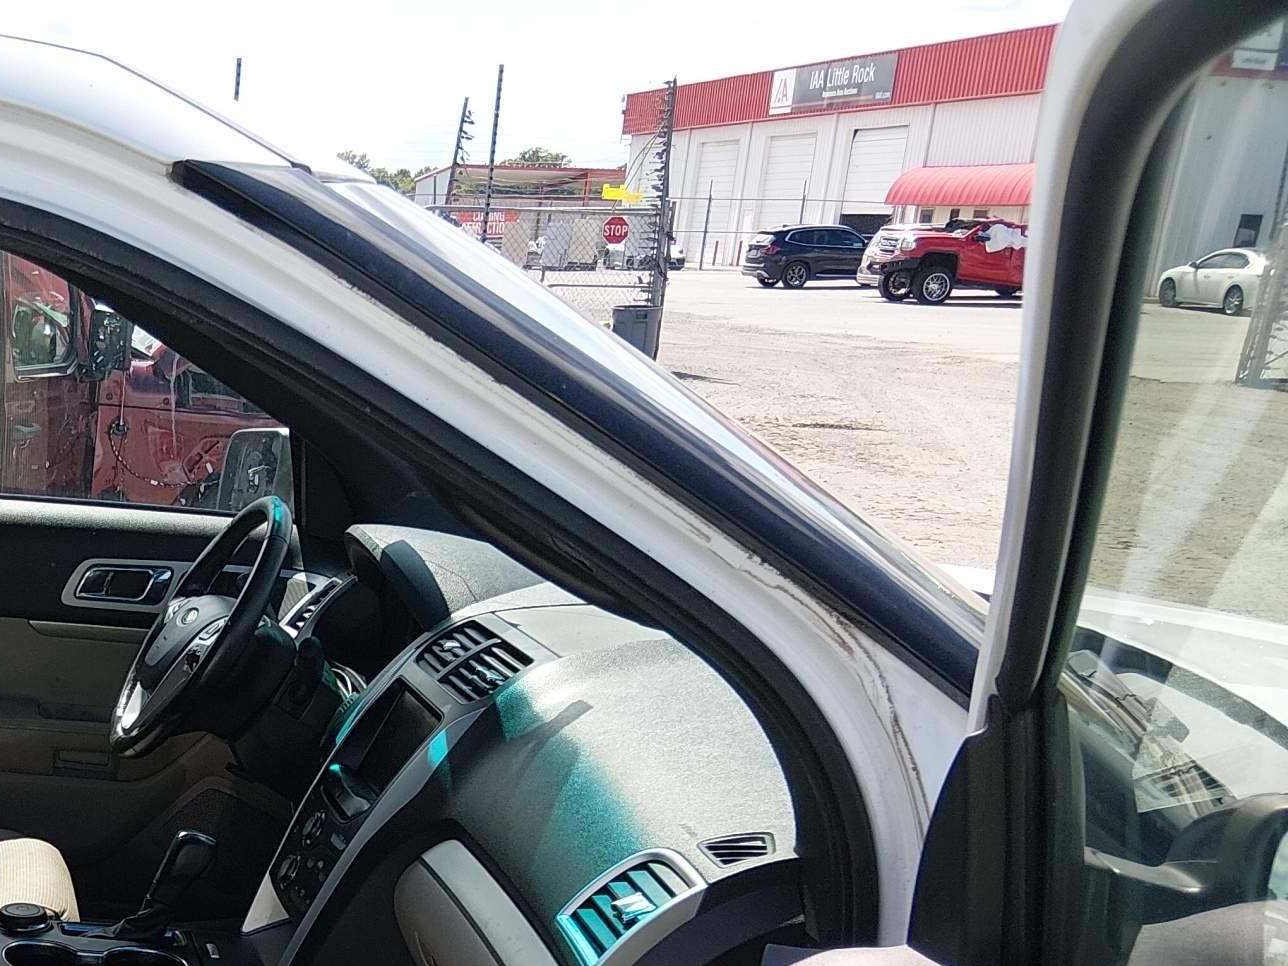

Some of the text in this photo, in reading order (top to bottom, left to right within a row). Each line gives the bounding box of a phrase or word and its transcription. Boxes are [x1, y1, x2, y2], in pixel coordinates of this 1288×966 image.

[809, 62, 876, 90] IAA Little Rock
[603, 224, 628, 237] STOP
